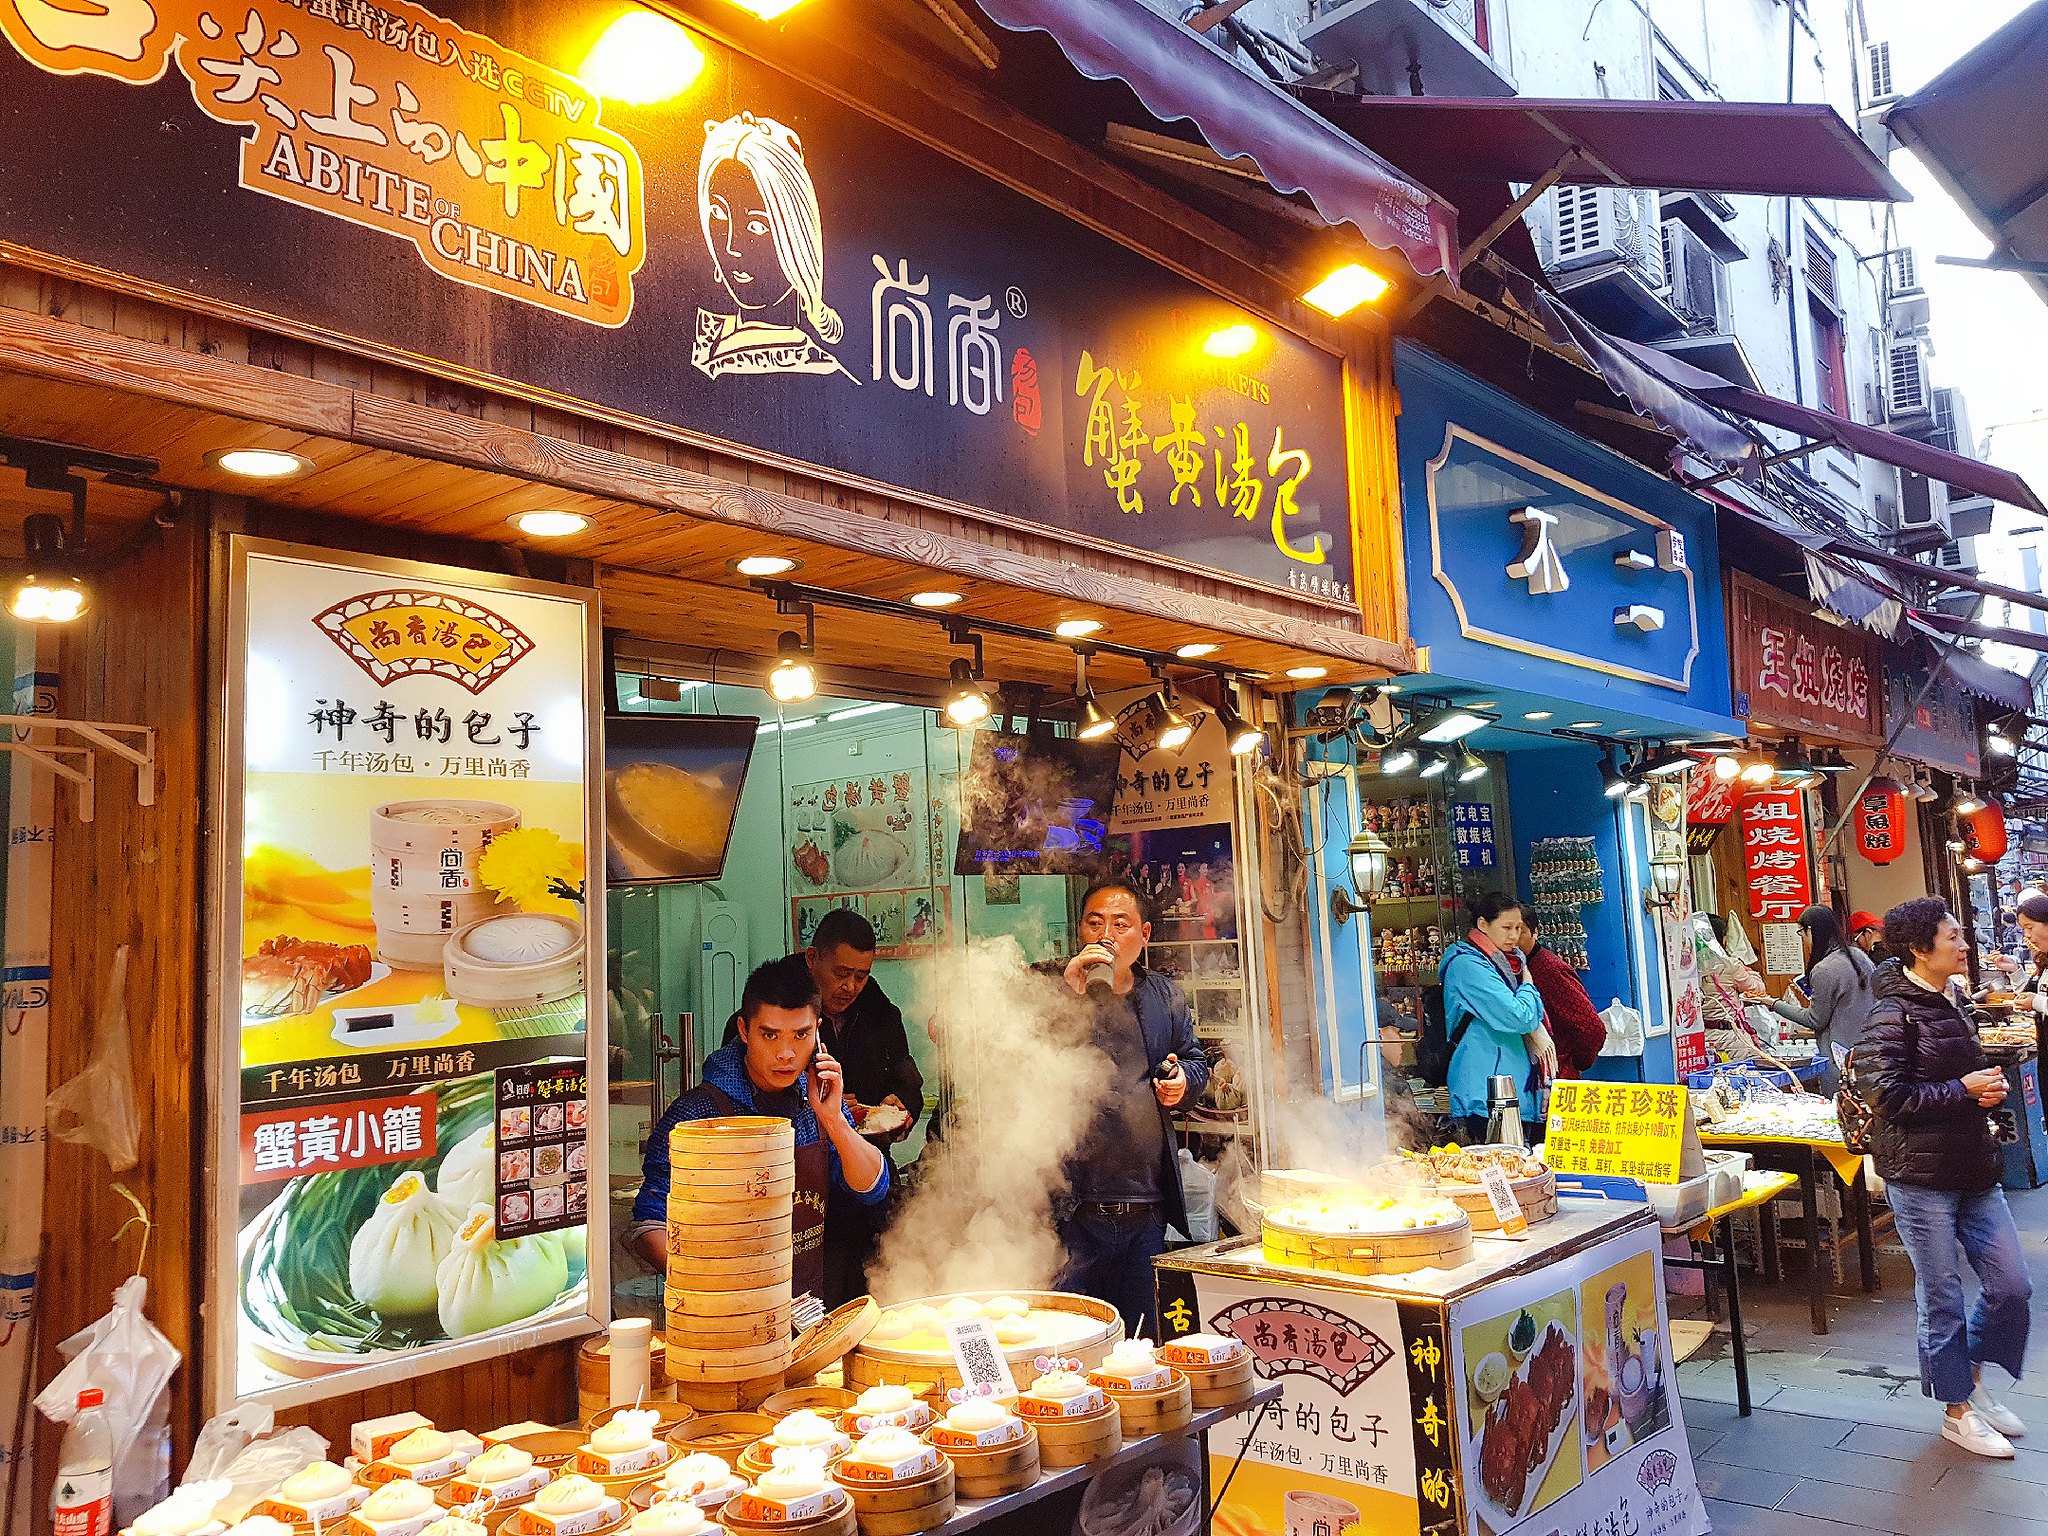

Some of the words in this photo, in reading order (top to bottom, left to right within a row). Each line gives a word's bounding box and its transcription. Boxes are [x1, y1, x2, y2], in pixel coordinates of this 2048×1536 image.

[435, 198, 461, 219] OF
[430, 217, 589, 304] CHINA
[307, 699, 541, 750] 神奇的包子
[1455, 805, 1492, 823] 充电宝
[1456, 826, 1493, 844] 数据线
[262, 1062, 362, 1093] 千年汤包
[386, 1050, 476, 1079] 万里尚香
[1555, 1085, 1679, 1120] 现杀活珍珠
[1164, 1298, 1193, 1333] 舌
